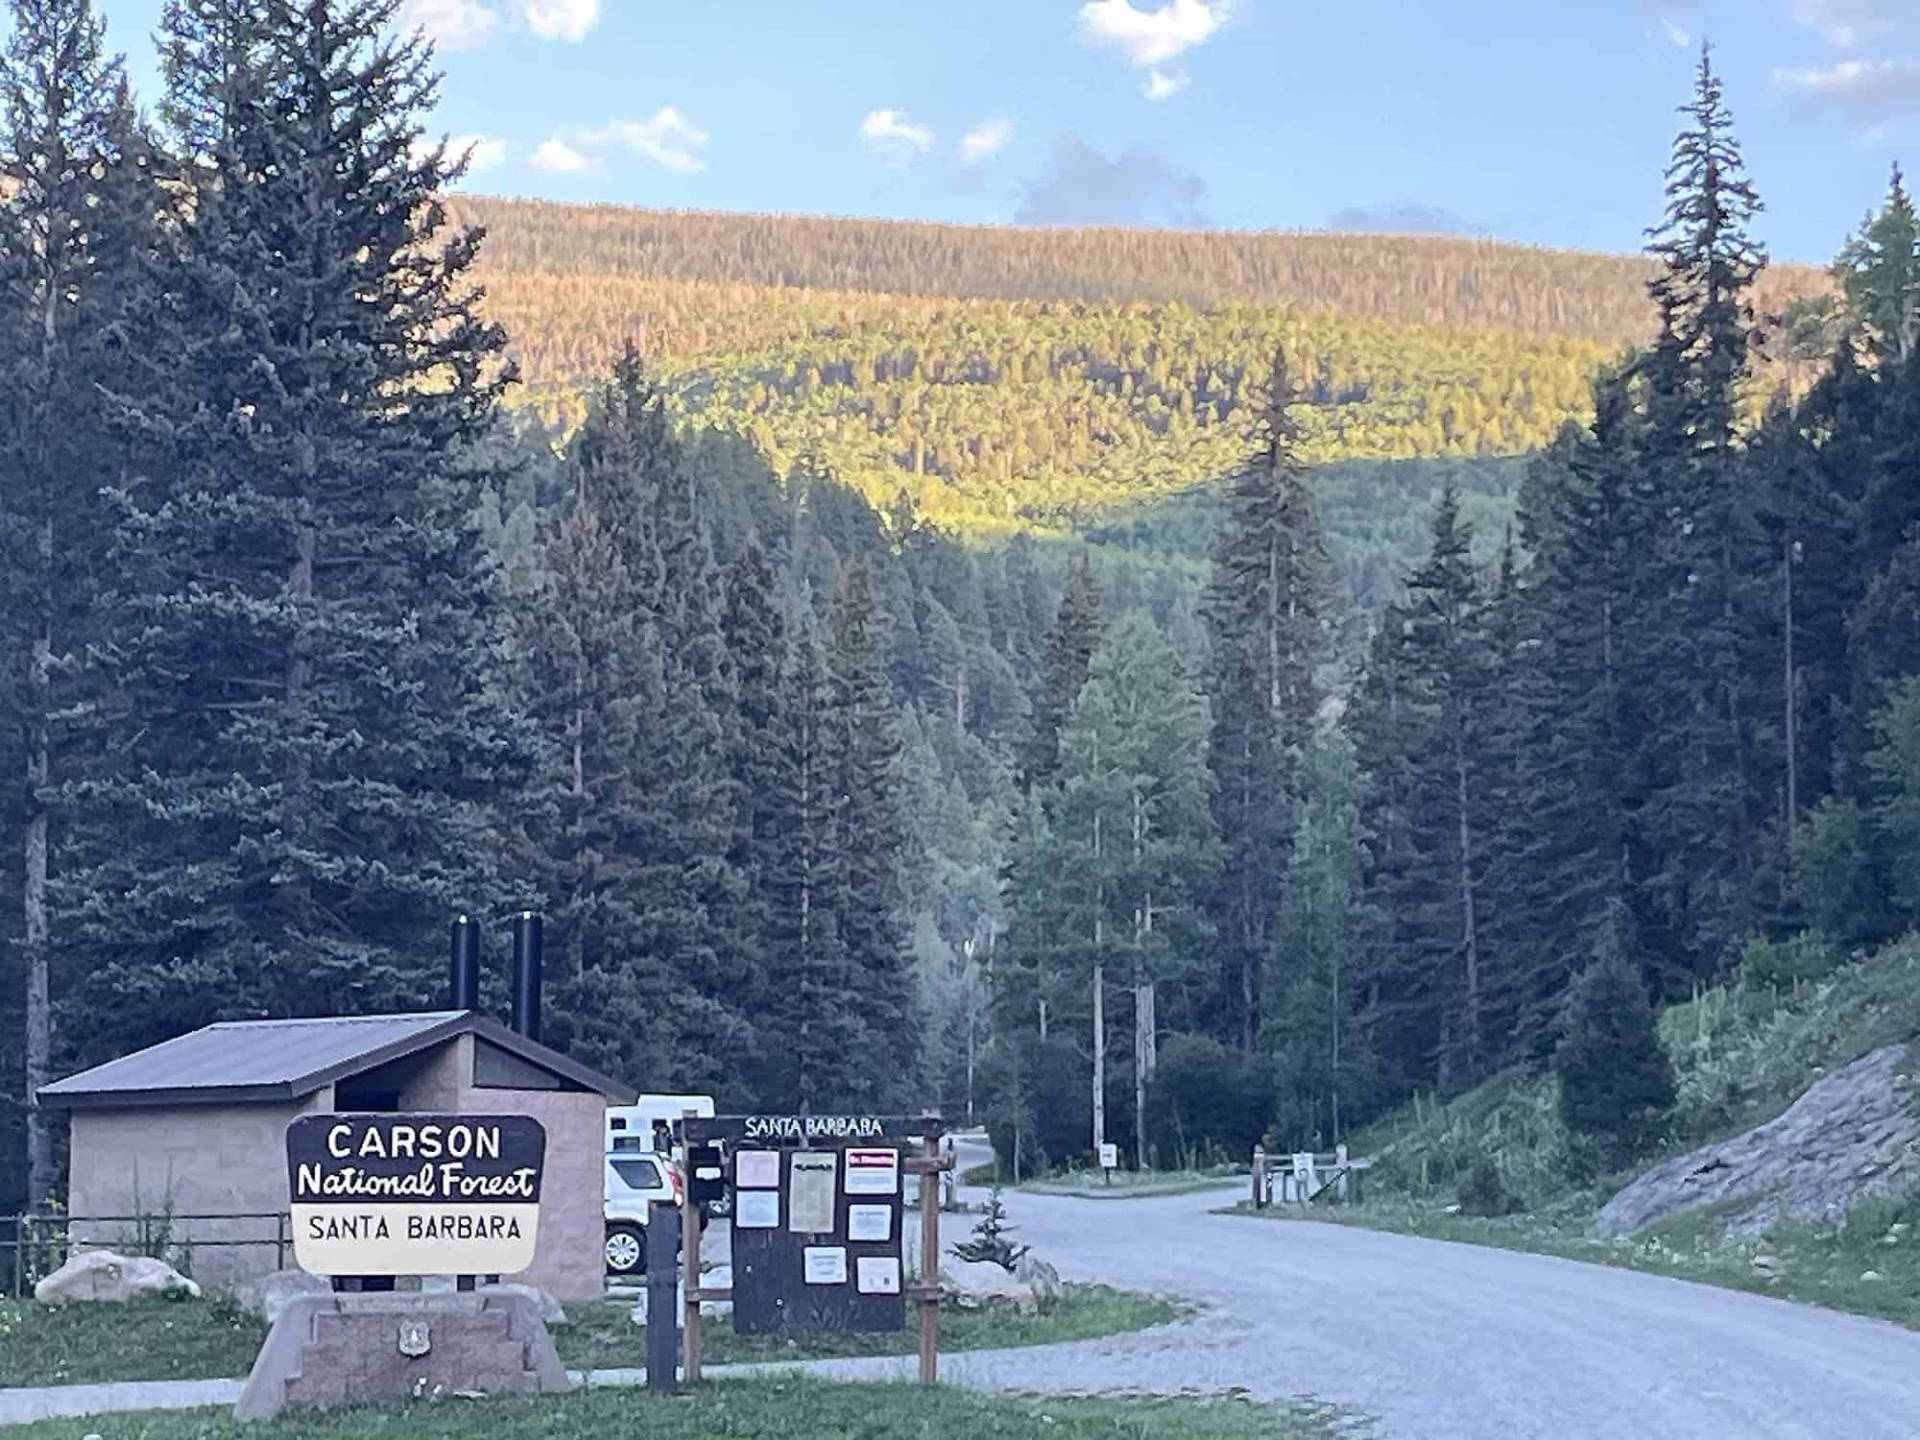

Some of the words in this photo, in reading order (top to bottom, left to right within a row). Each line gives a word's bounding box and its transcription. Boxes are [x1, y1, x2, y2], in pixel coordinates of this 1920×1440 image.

[328, 1125, 499, 1158] CARSON
[745, 1117, 801, 1137] SANTA
[805, 1117, 884, 1137] BARBARA
[298, 1163, 434, 1196] National
[439, 1163, 537, 1197] Forest
[308, 1215, 390, 1240] SANTA
[407, 1215, 521, 1240] BARBARA
